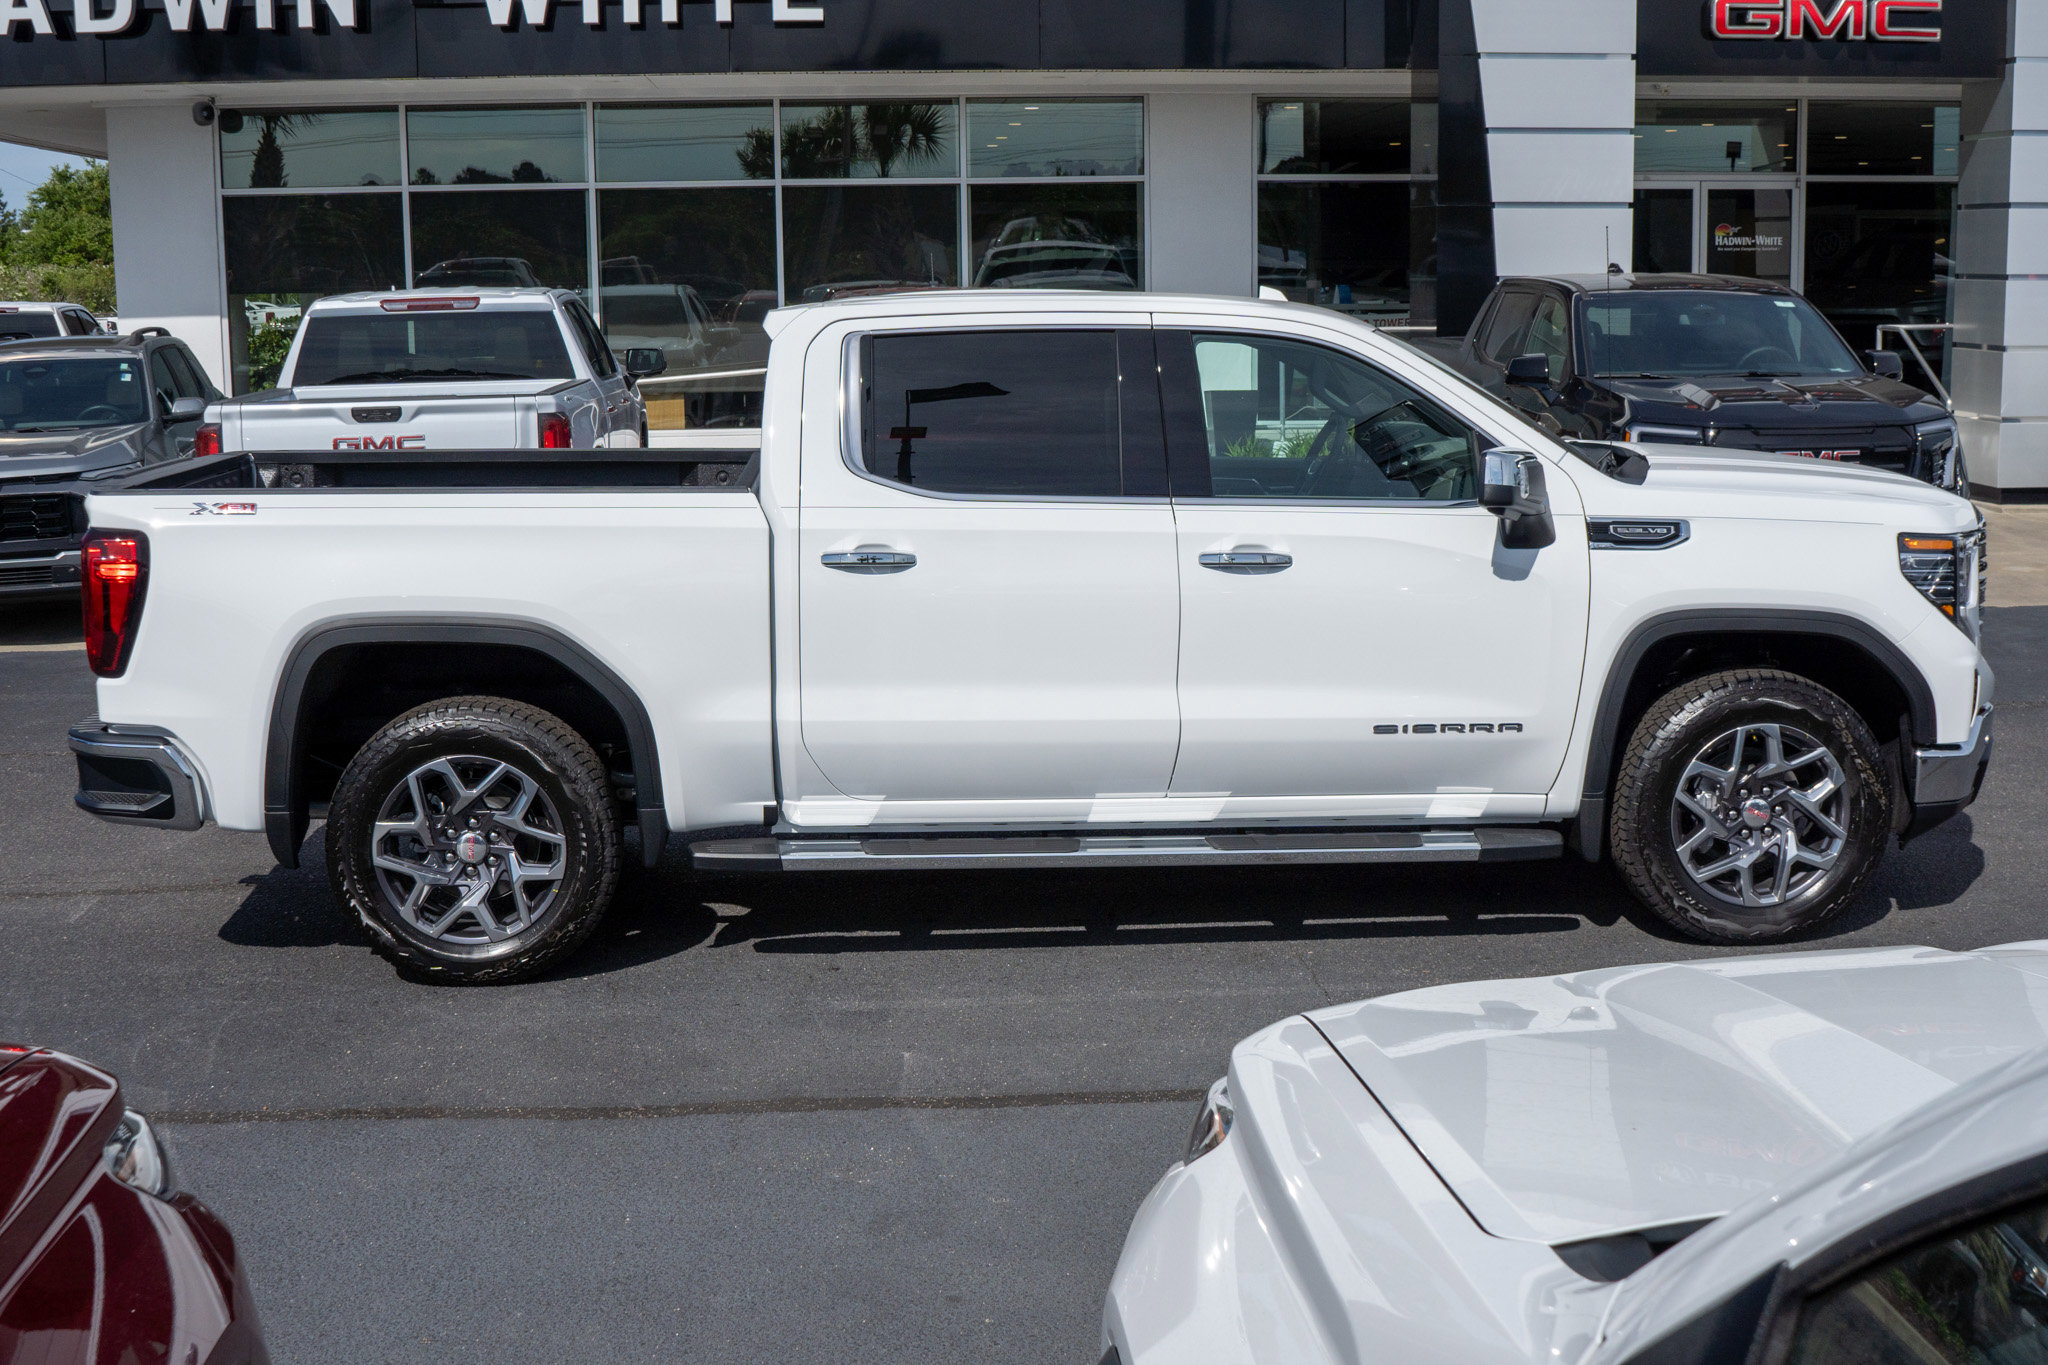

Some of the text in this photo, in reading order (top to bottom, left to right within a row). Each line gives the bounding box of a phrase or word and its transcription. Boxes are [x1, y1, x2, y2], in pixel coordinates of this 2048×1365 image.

[1712, 0, 1942, 41] GMC
[332, 434, 425, 450] GMC
[1373, 723, 1523, 734] SIERRA
